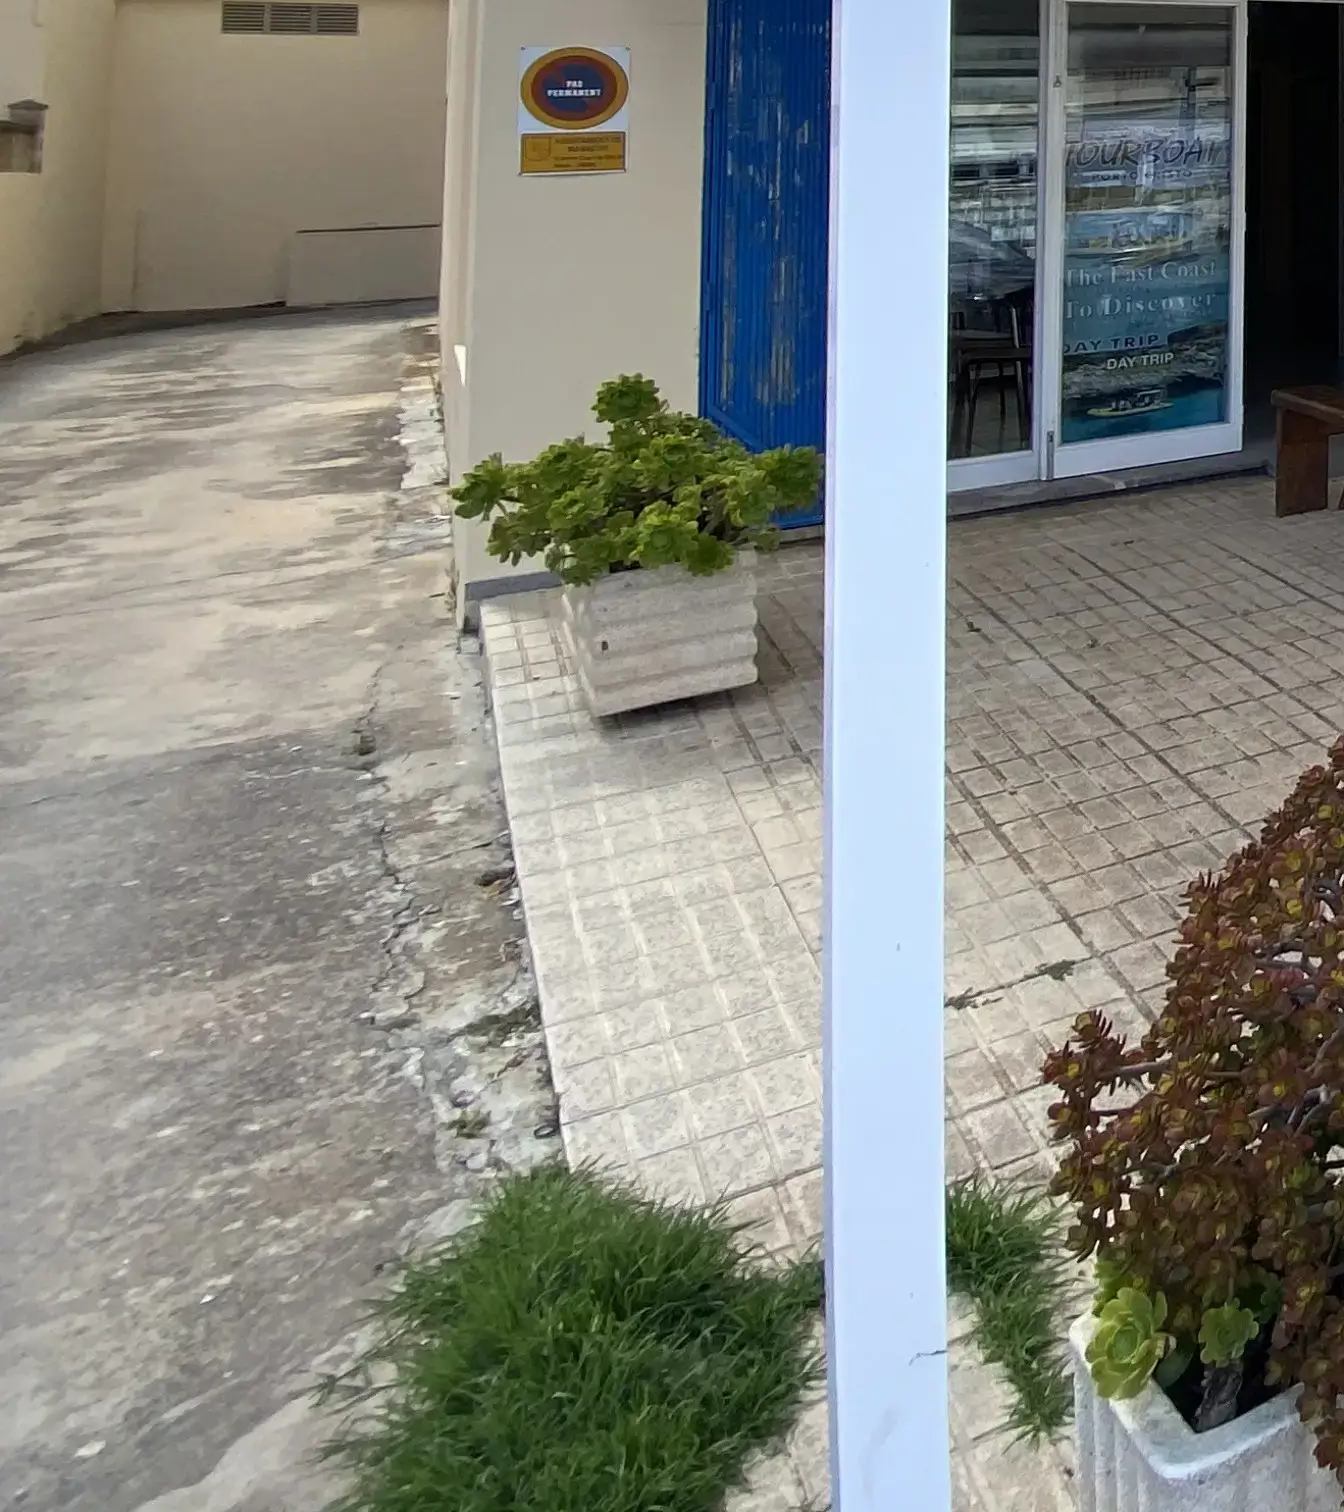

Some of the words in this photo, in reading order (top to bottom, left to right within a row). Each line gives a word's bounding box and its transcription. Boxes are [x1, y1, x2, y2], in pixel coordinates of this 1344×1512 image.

[1160, 260, 1216, 280] Coast
[1065, 300, 1093, 319] To
[1100, 292, 1216, 316] Discover
[1110, 334, 1160, 350] TRIP
[1106, 356, 1137, 370] DAY
[1141, 352, 1175, 367] TRIP
